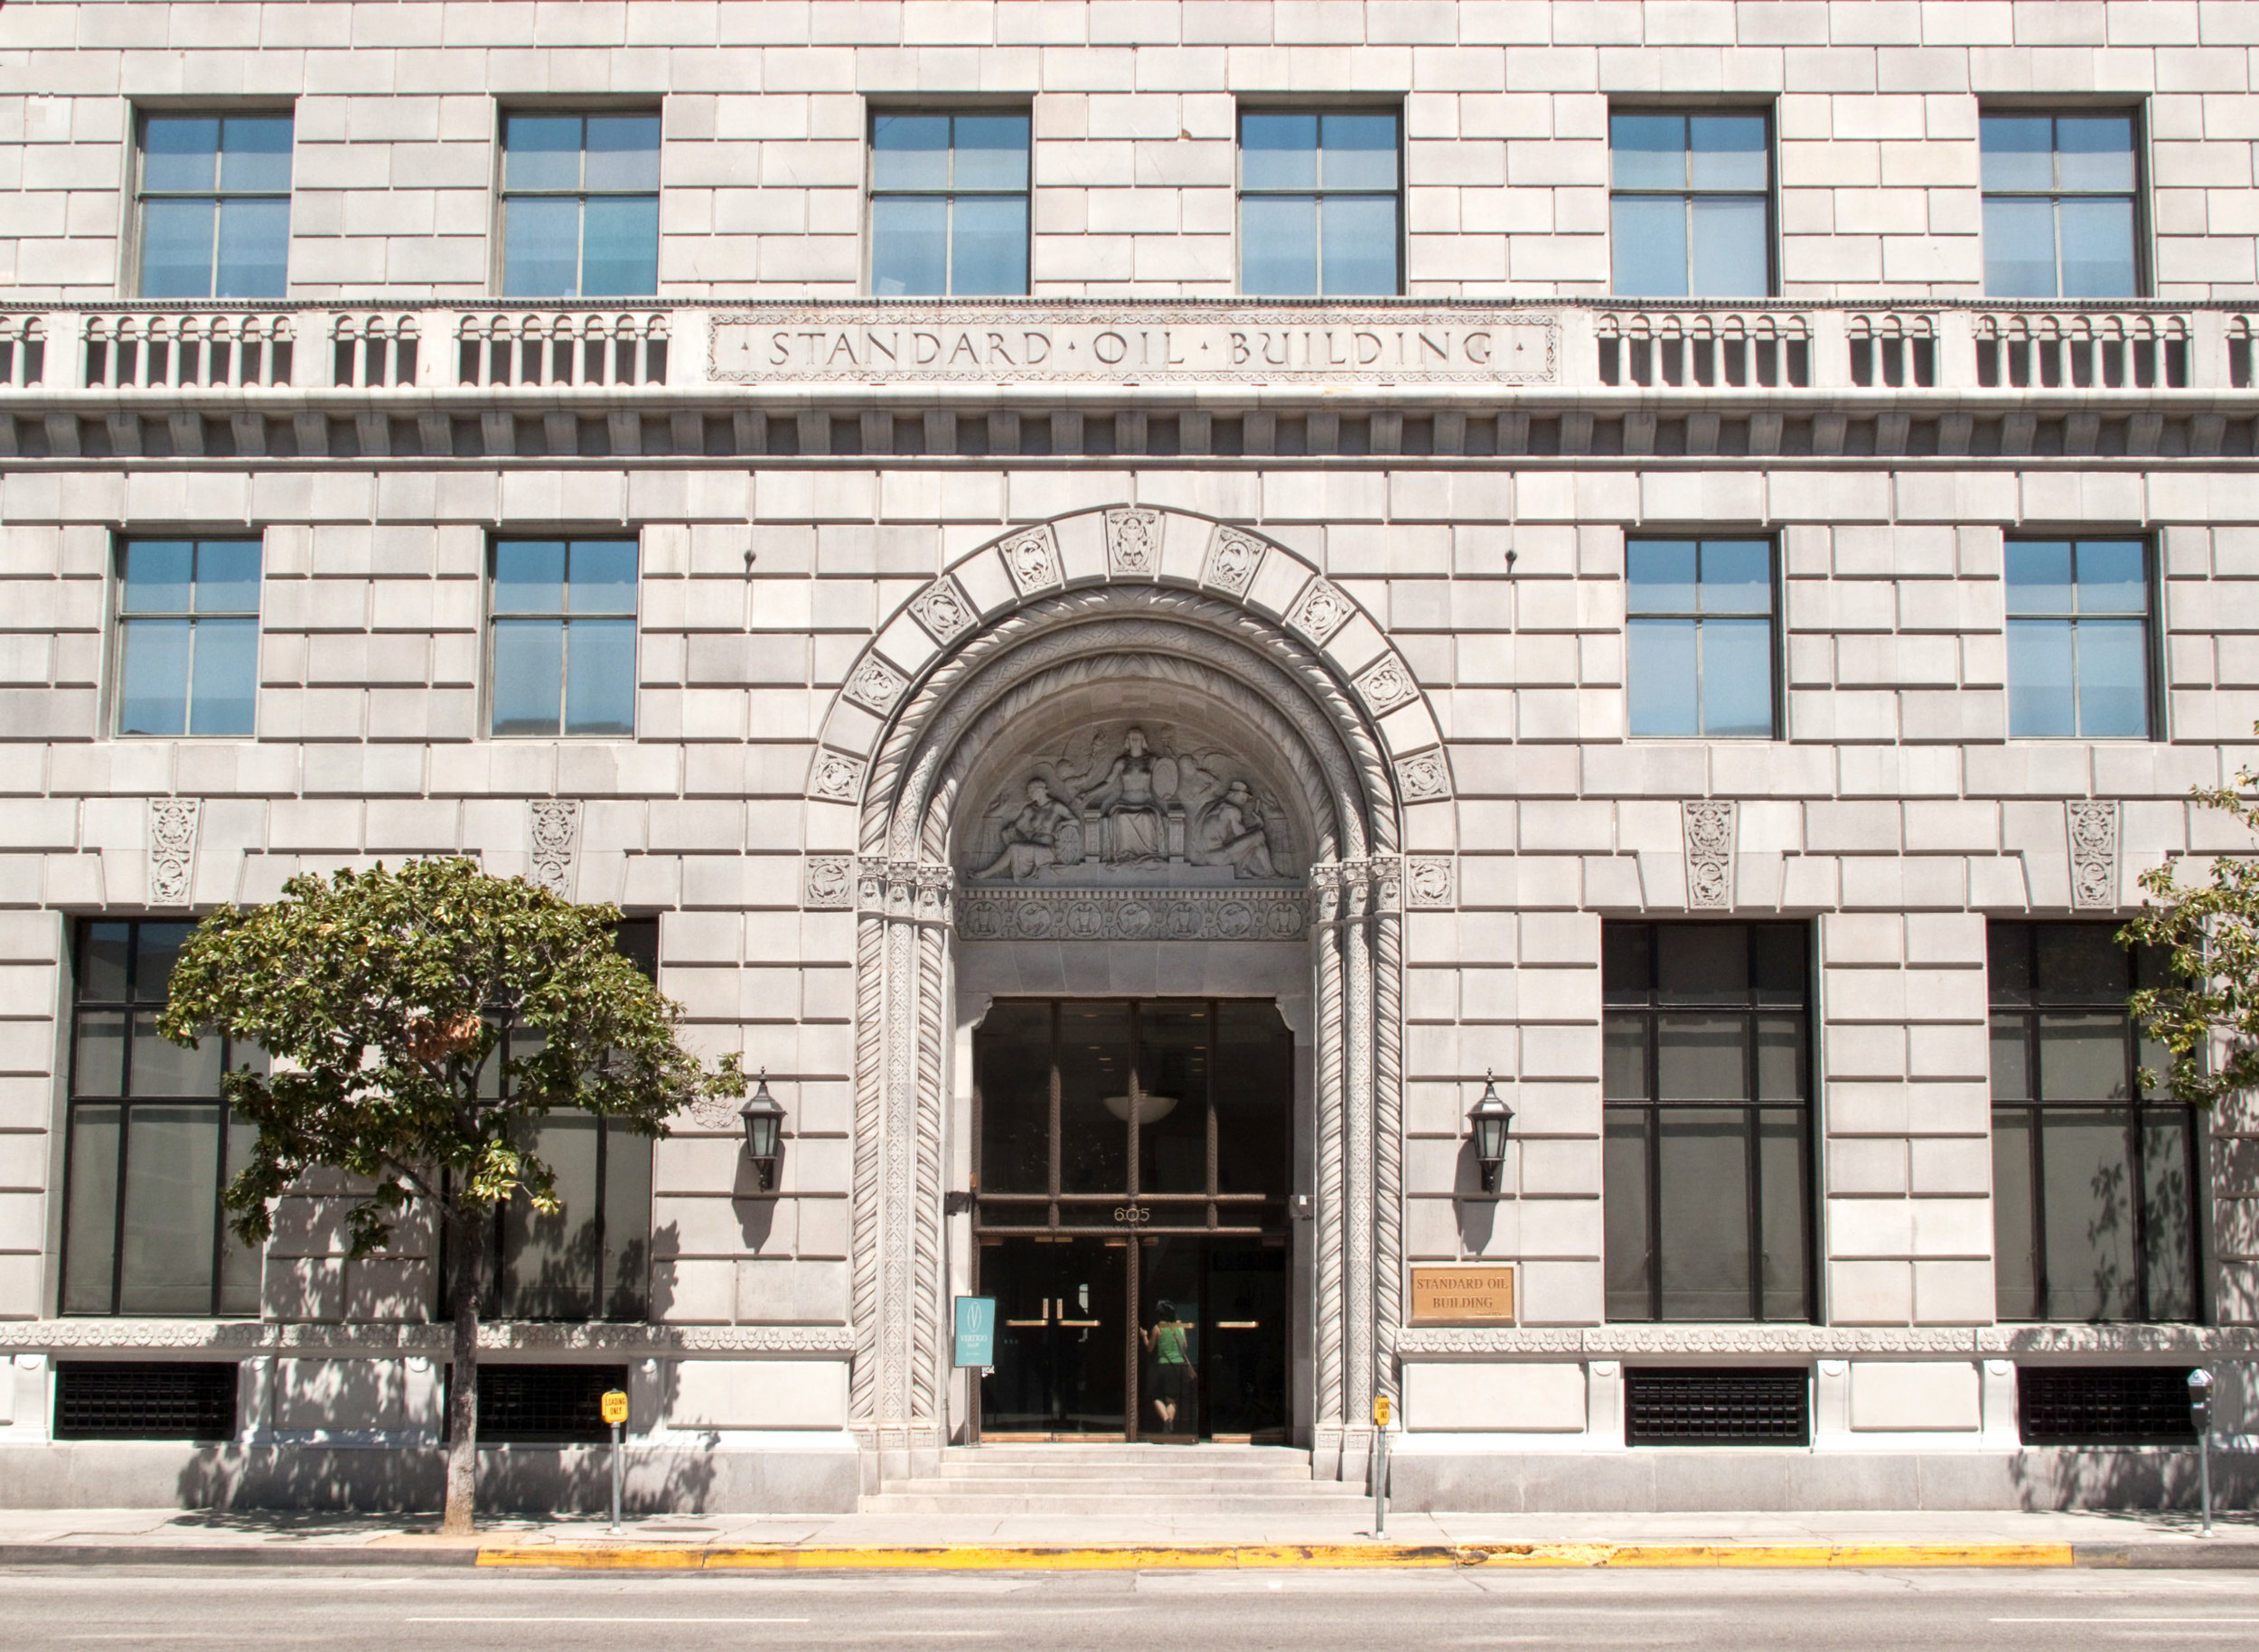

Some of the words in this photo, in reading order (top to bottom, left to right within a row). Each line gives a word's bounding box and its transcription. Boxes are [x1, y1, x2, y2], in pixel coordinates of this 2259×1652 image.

[769, 332, 1052, 365] STANDARD
[1092, 331, 1185, 365] OIL
[1229, 332, 1492, 365] BUILDING
[1114, 1206, 1150, 1222] 605
[1416, 1278, 1483, 1290] STANDARD
[1487, 1278, 1508, 1290] OIL
[1432, 1297, 1493, 1309] BUILDING
[605, 1397, 626, 1406] LOADING
[609, 1406, 623, 1415] ONLY
